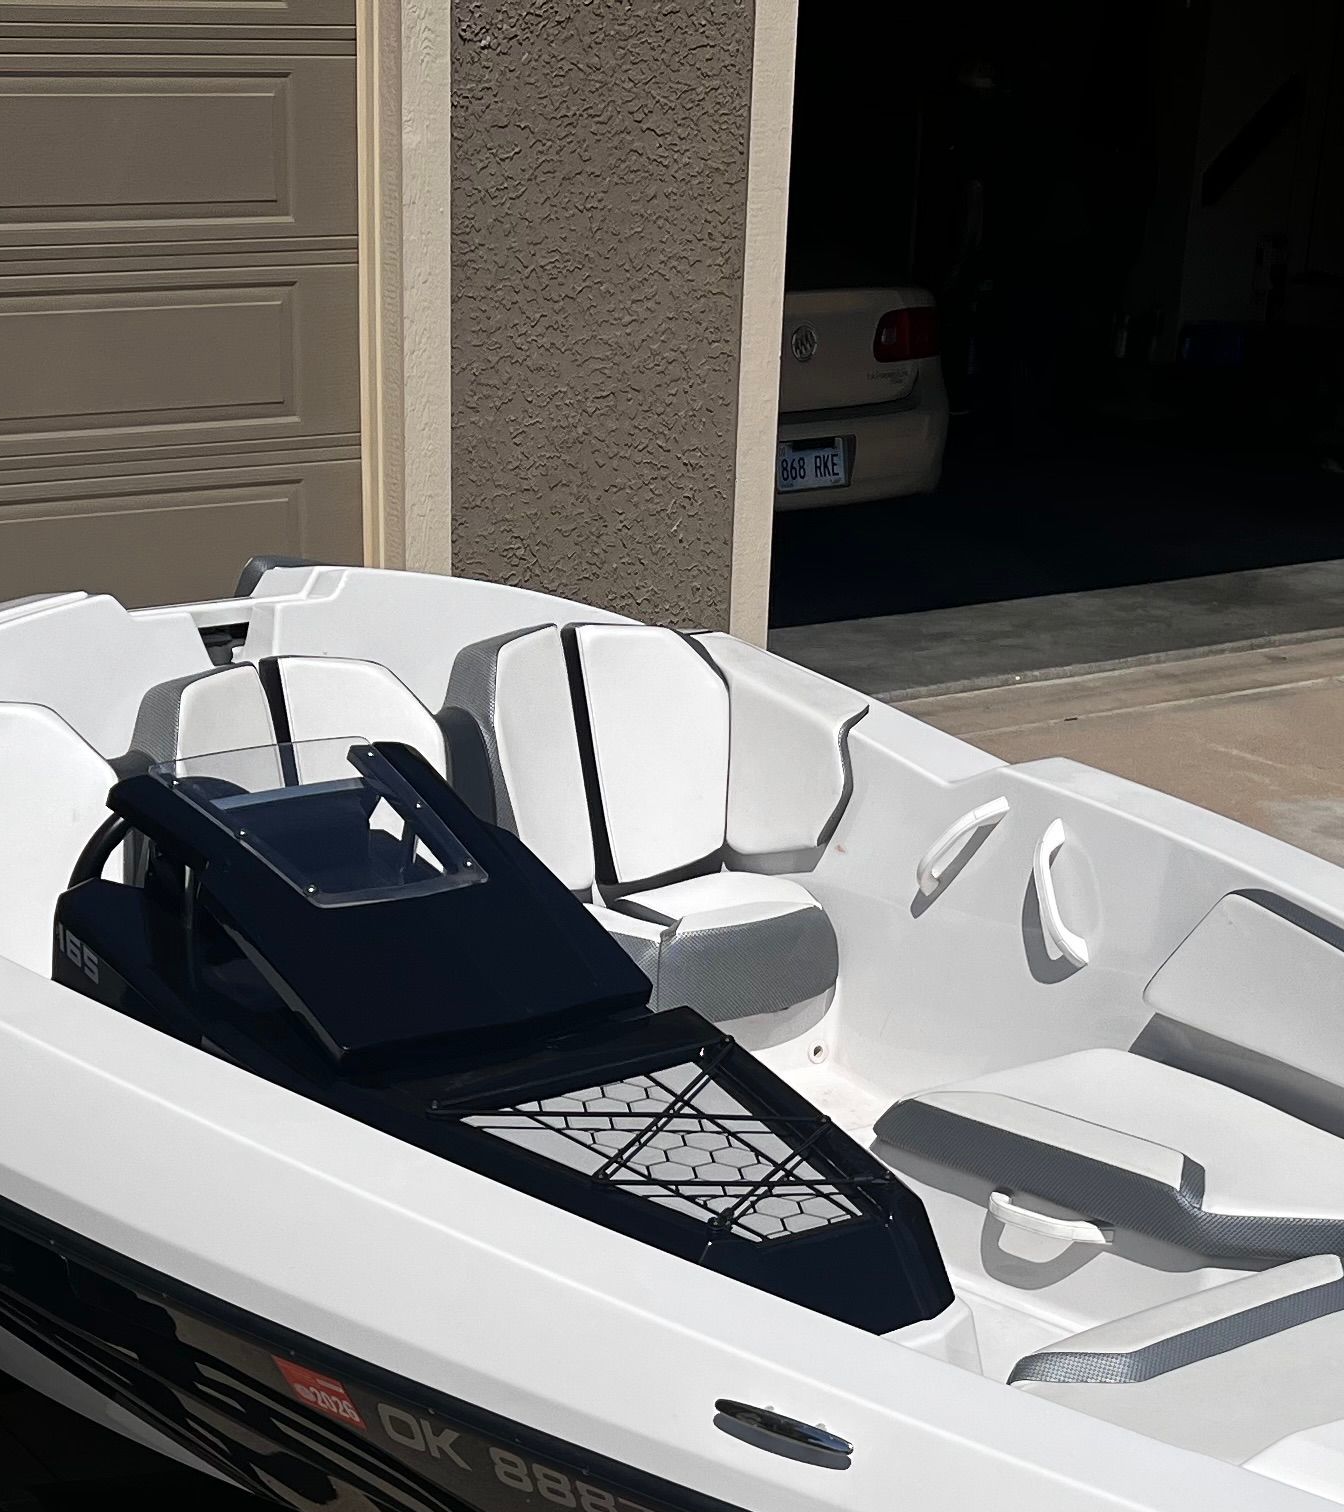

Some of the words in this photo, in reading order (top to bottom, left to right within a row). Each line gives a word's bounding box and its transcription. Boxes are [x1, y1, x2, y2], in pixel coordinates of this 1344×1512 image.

[781, 457, 806, 481] 868
[814, 454, 840, 478] RKE
[57, 920, 99, 985] 165
[309, 1386, 360, 1423] 2026
[377, 1403, 472, 1471] OK
